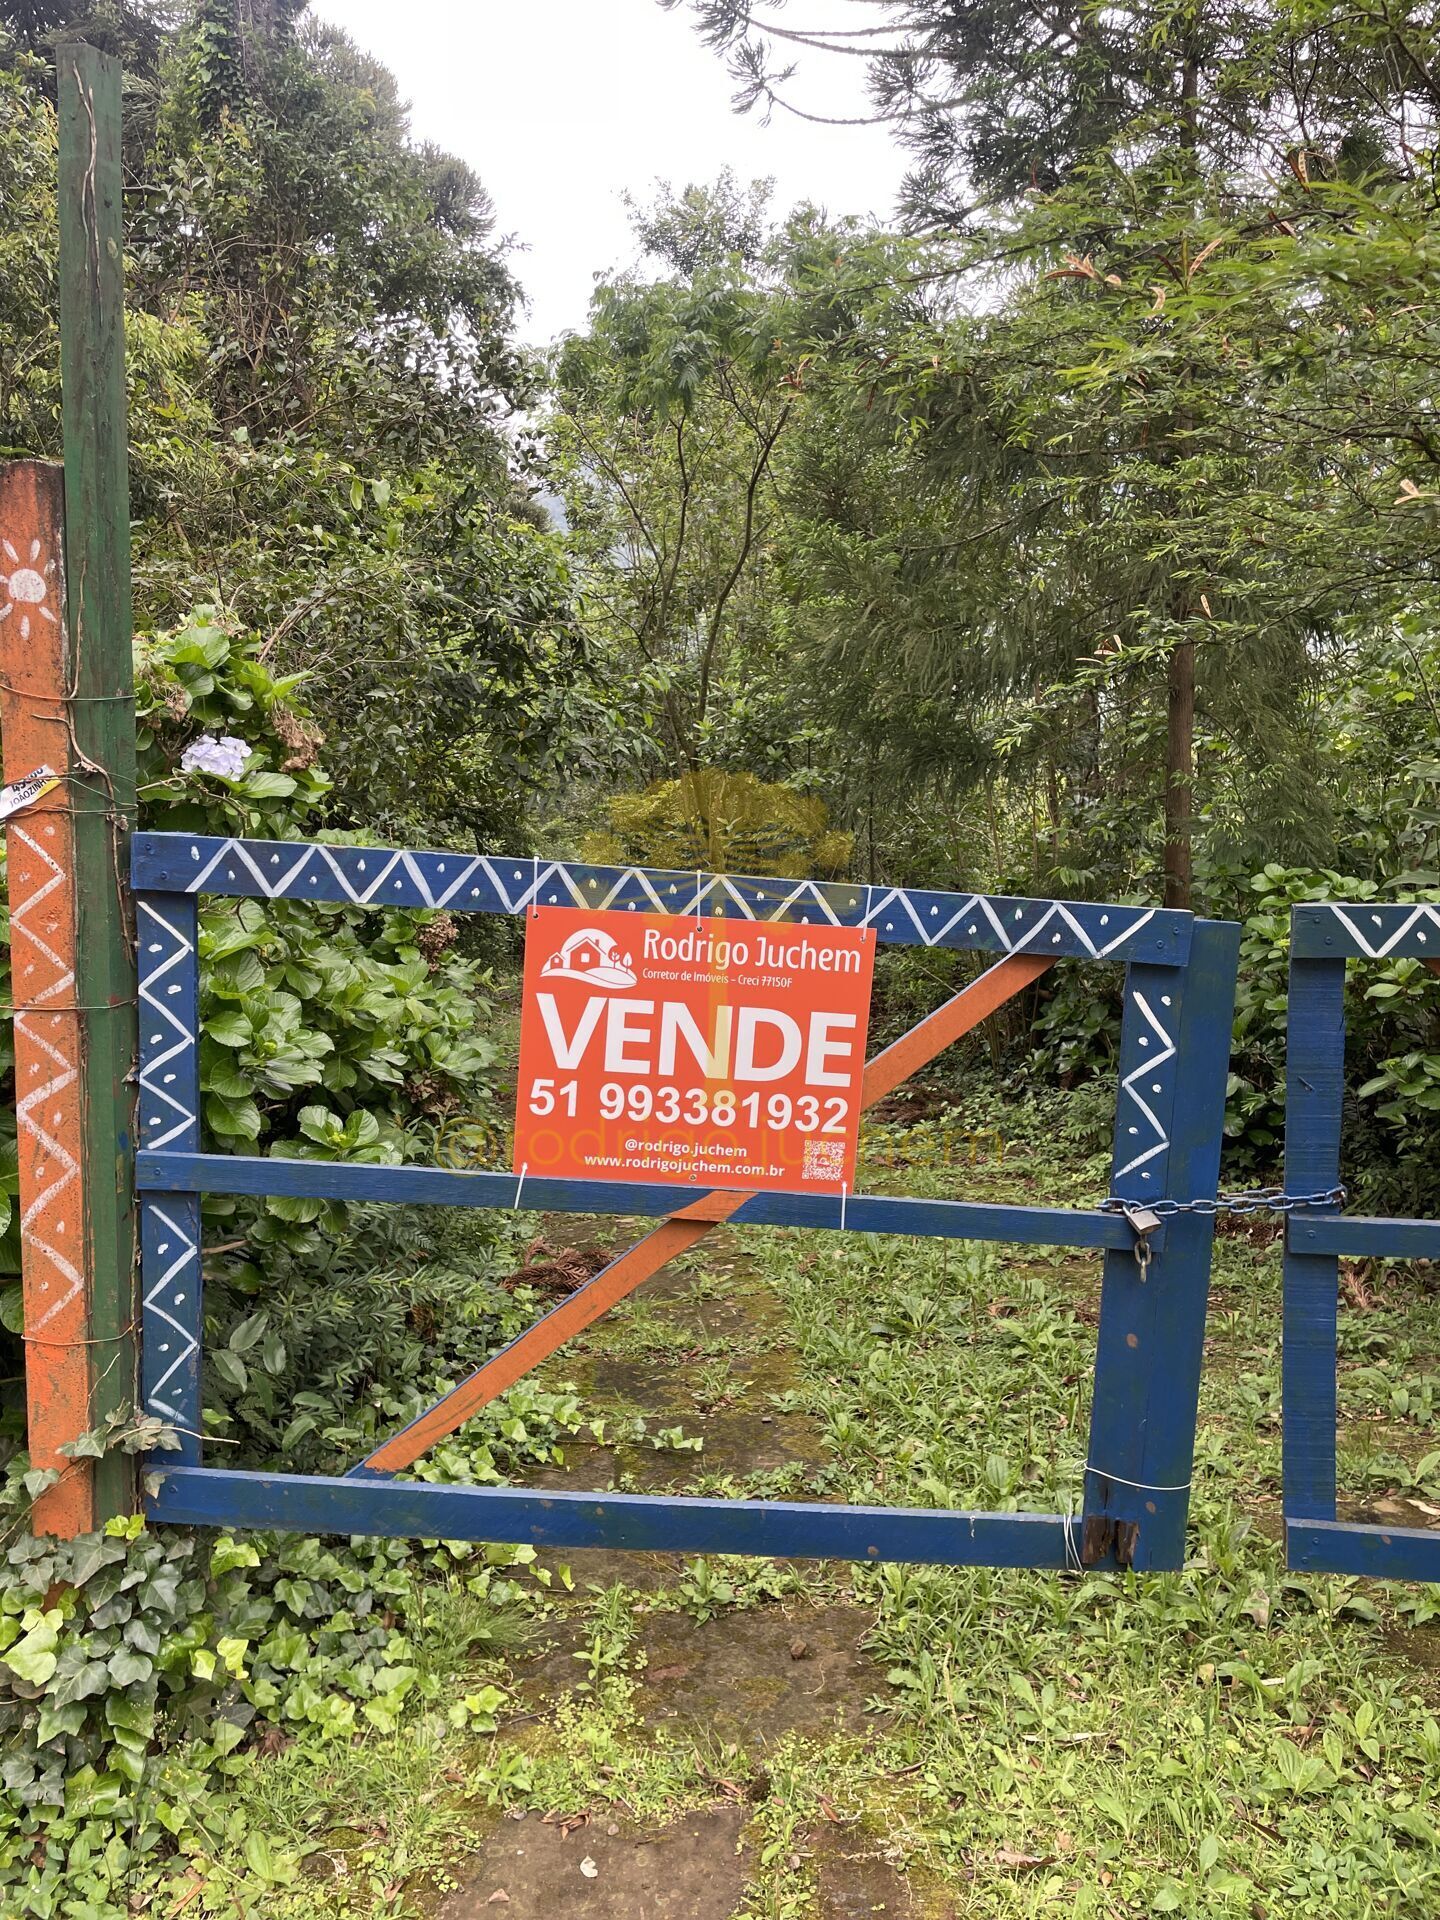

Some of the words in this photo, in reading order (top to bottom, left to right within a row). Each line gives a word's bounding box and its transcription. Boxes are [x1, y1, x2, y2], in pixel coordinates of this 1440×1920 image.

[643, 929, 749, 970] Rodrigo
[754, 936, 860, 974] Juchem
[643, 967, 679, 981] Corretor
[680, 970, 692, 981] de
[693, 971, 729, 983] Imóveis
[738, 973, 759, 986] Creci
[536, 992, 857, 1087] VENDE
[529, 1078, 578, 1117] 51
[599, 1079, 849, 1134] 993381932
[624, 1138, 748, 1158] @rodrigo.juchem
[584, 1154, 785, 1177] www.rodrigojuchem.com.br
